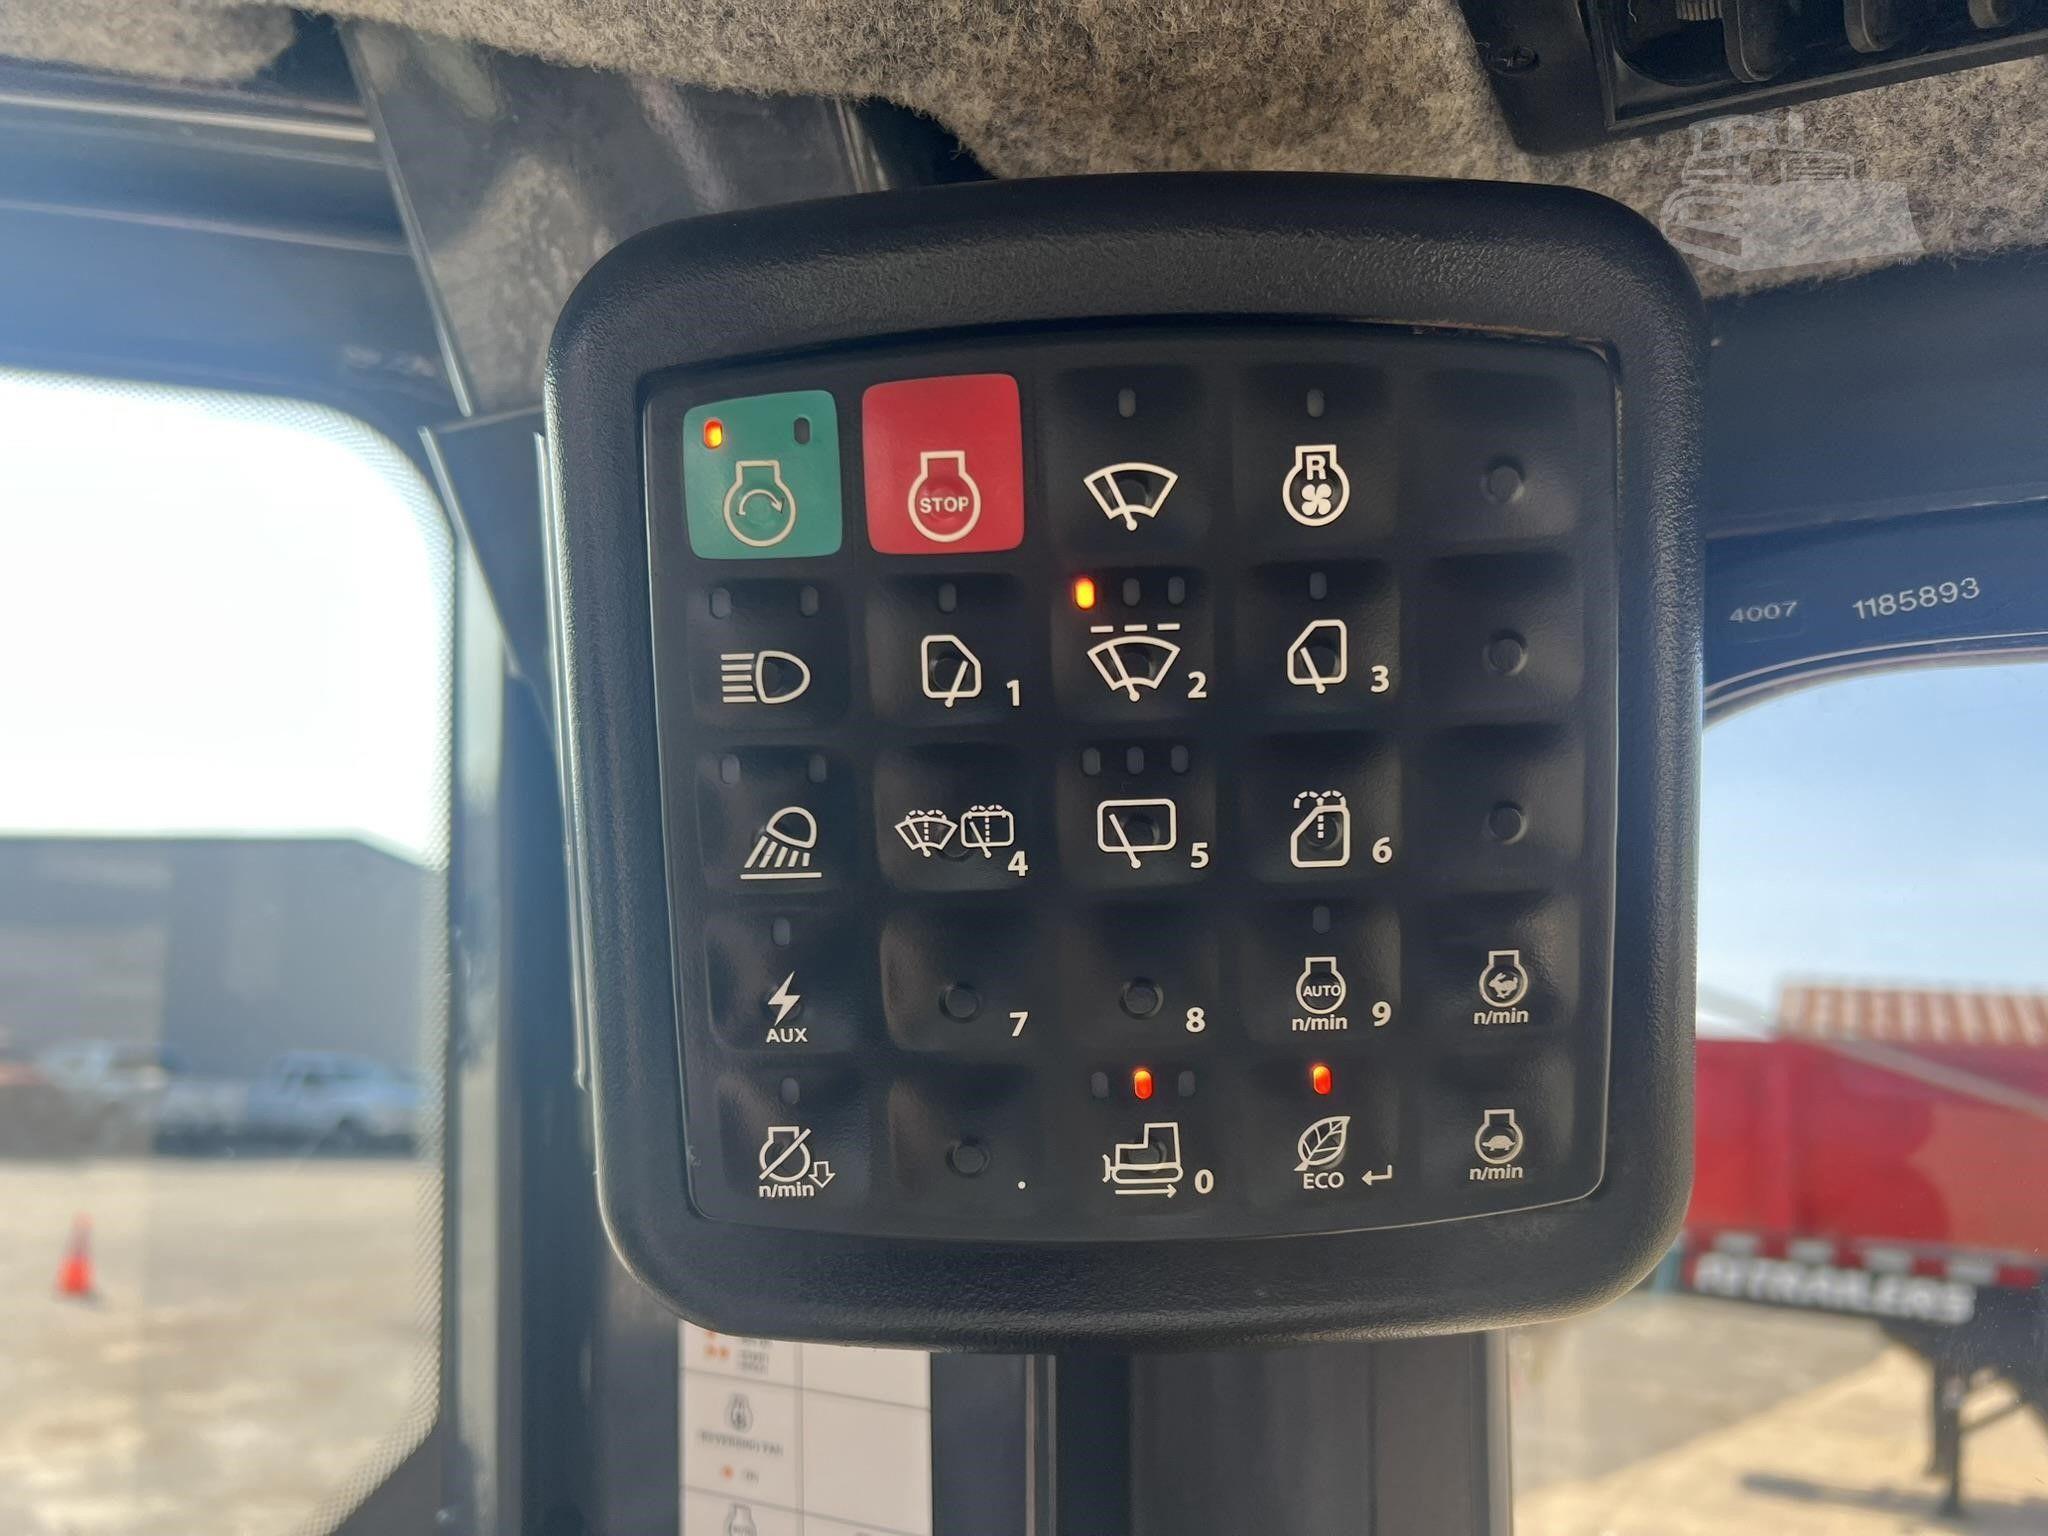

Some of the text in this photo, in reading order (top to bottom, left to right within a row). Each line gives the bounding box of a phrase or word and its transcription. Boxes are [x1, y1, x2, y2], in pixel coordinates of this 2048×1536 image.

[1306, 454, 1327, 481] R
[919, 496, 970, 514] STOP
[1852, 577, 1980, 620] 1185893
[1729, 601, 1797, 623] 4007
[1187, 671, 1208, 699] 2
[1370, 665, 1390, 693] 3
[1006, 679, 1021, 707] 1
[1190, 842, 1209, 869] 5
[1372, 836, 1393, 864] 6
[1007, 850, 1029, 877] 4
[1302, 983, 1341, 998] AUTO
[1008, 1010, 1029, 1037] 7
[1185, 1006, 1206, 1033] 8
[1291, 1014, 1348, 1032] n/min
[1372, 1001, 1392, 1027] 9
[1473, 1007, 1529, 1026] n/min
[766, 1027, 809, 1043] AUX
[1194, 1169, 1214, 1194] 0
[1302, 1172, 1345, 1190] ECO
[1469, 1164, 1523, 1182] n/min
[758, 1182, 815, 1199] n/min
